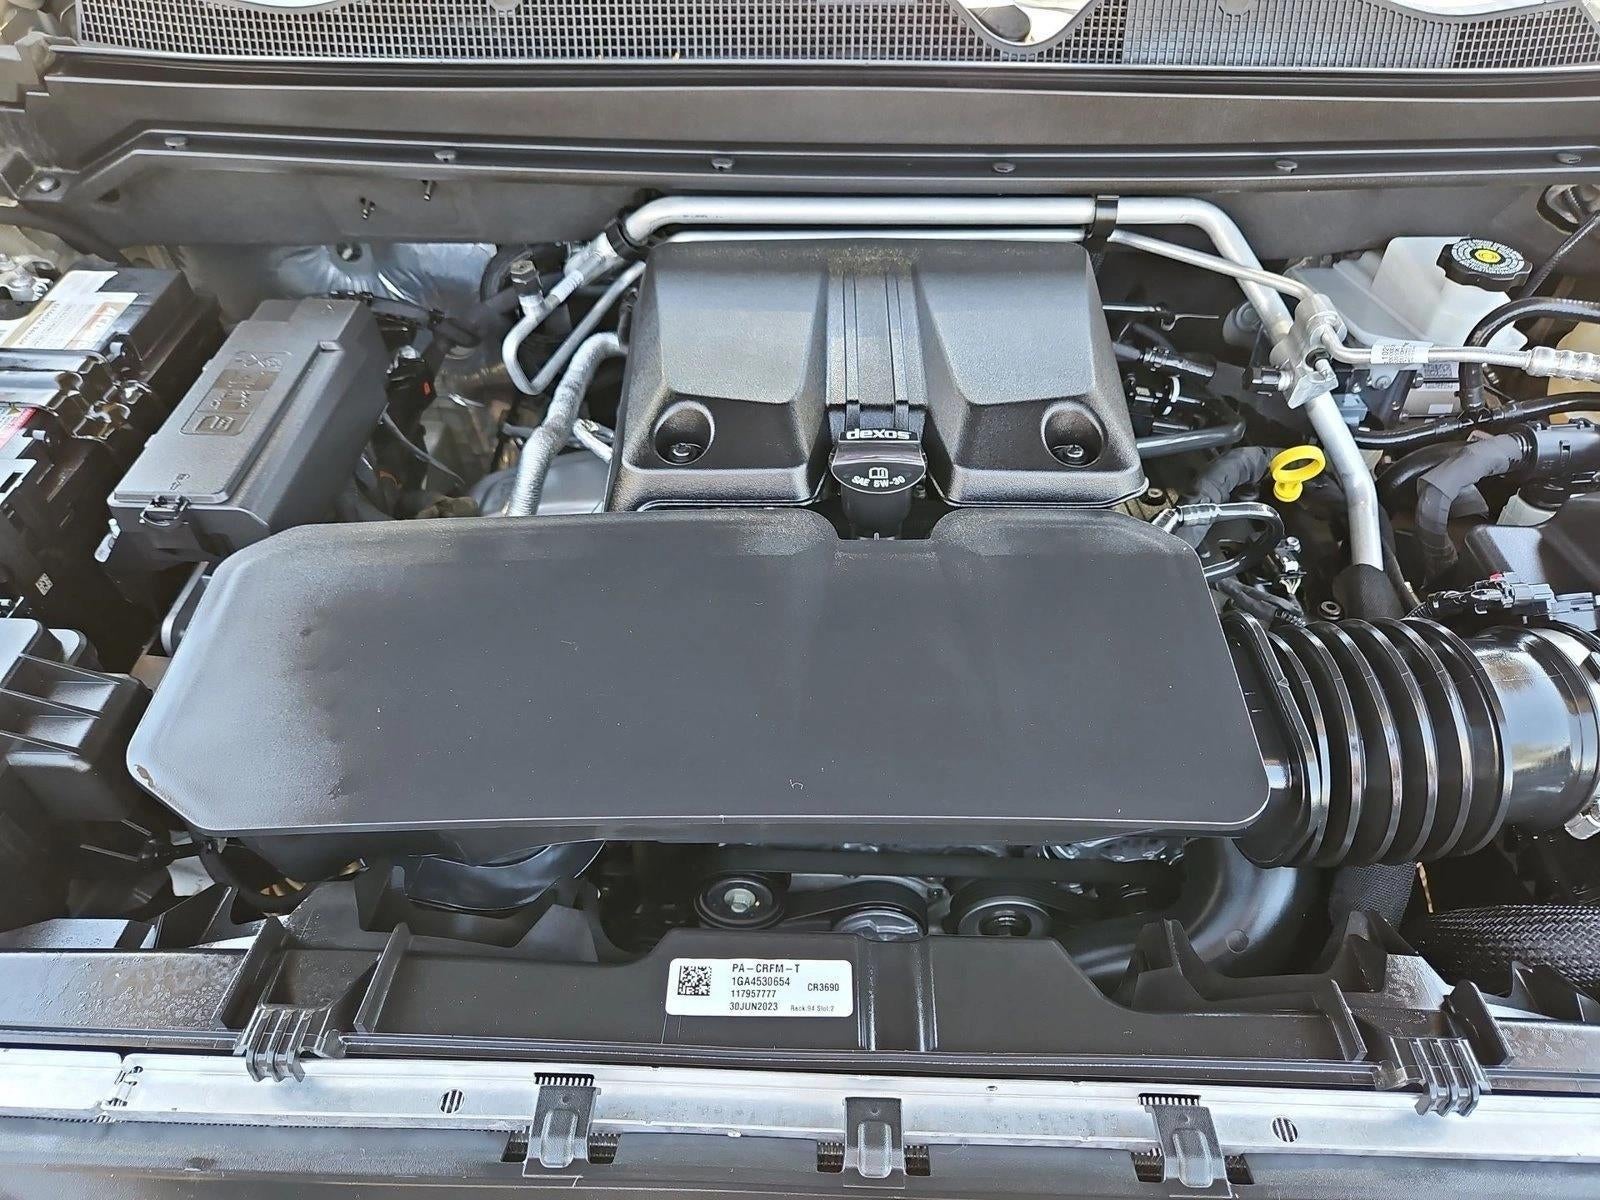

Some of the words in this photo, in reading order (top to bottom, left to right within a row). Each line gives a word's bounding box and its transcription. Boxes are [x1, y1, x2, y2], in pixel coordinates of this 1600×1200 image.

[846, 428, 911, 440] dexos
[851, 476, 870, 486] SAE
[732, 977, 790, 986] 1GA4530654
[807, 983, 839, 992] CR3690
[731, 990, 776, 998] 117957777
[729, 1002, 778, 1011] 30JUN2023
